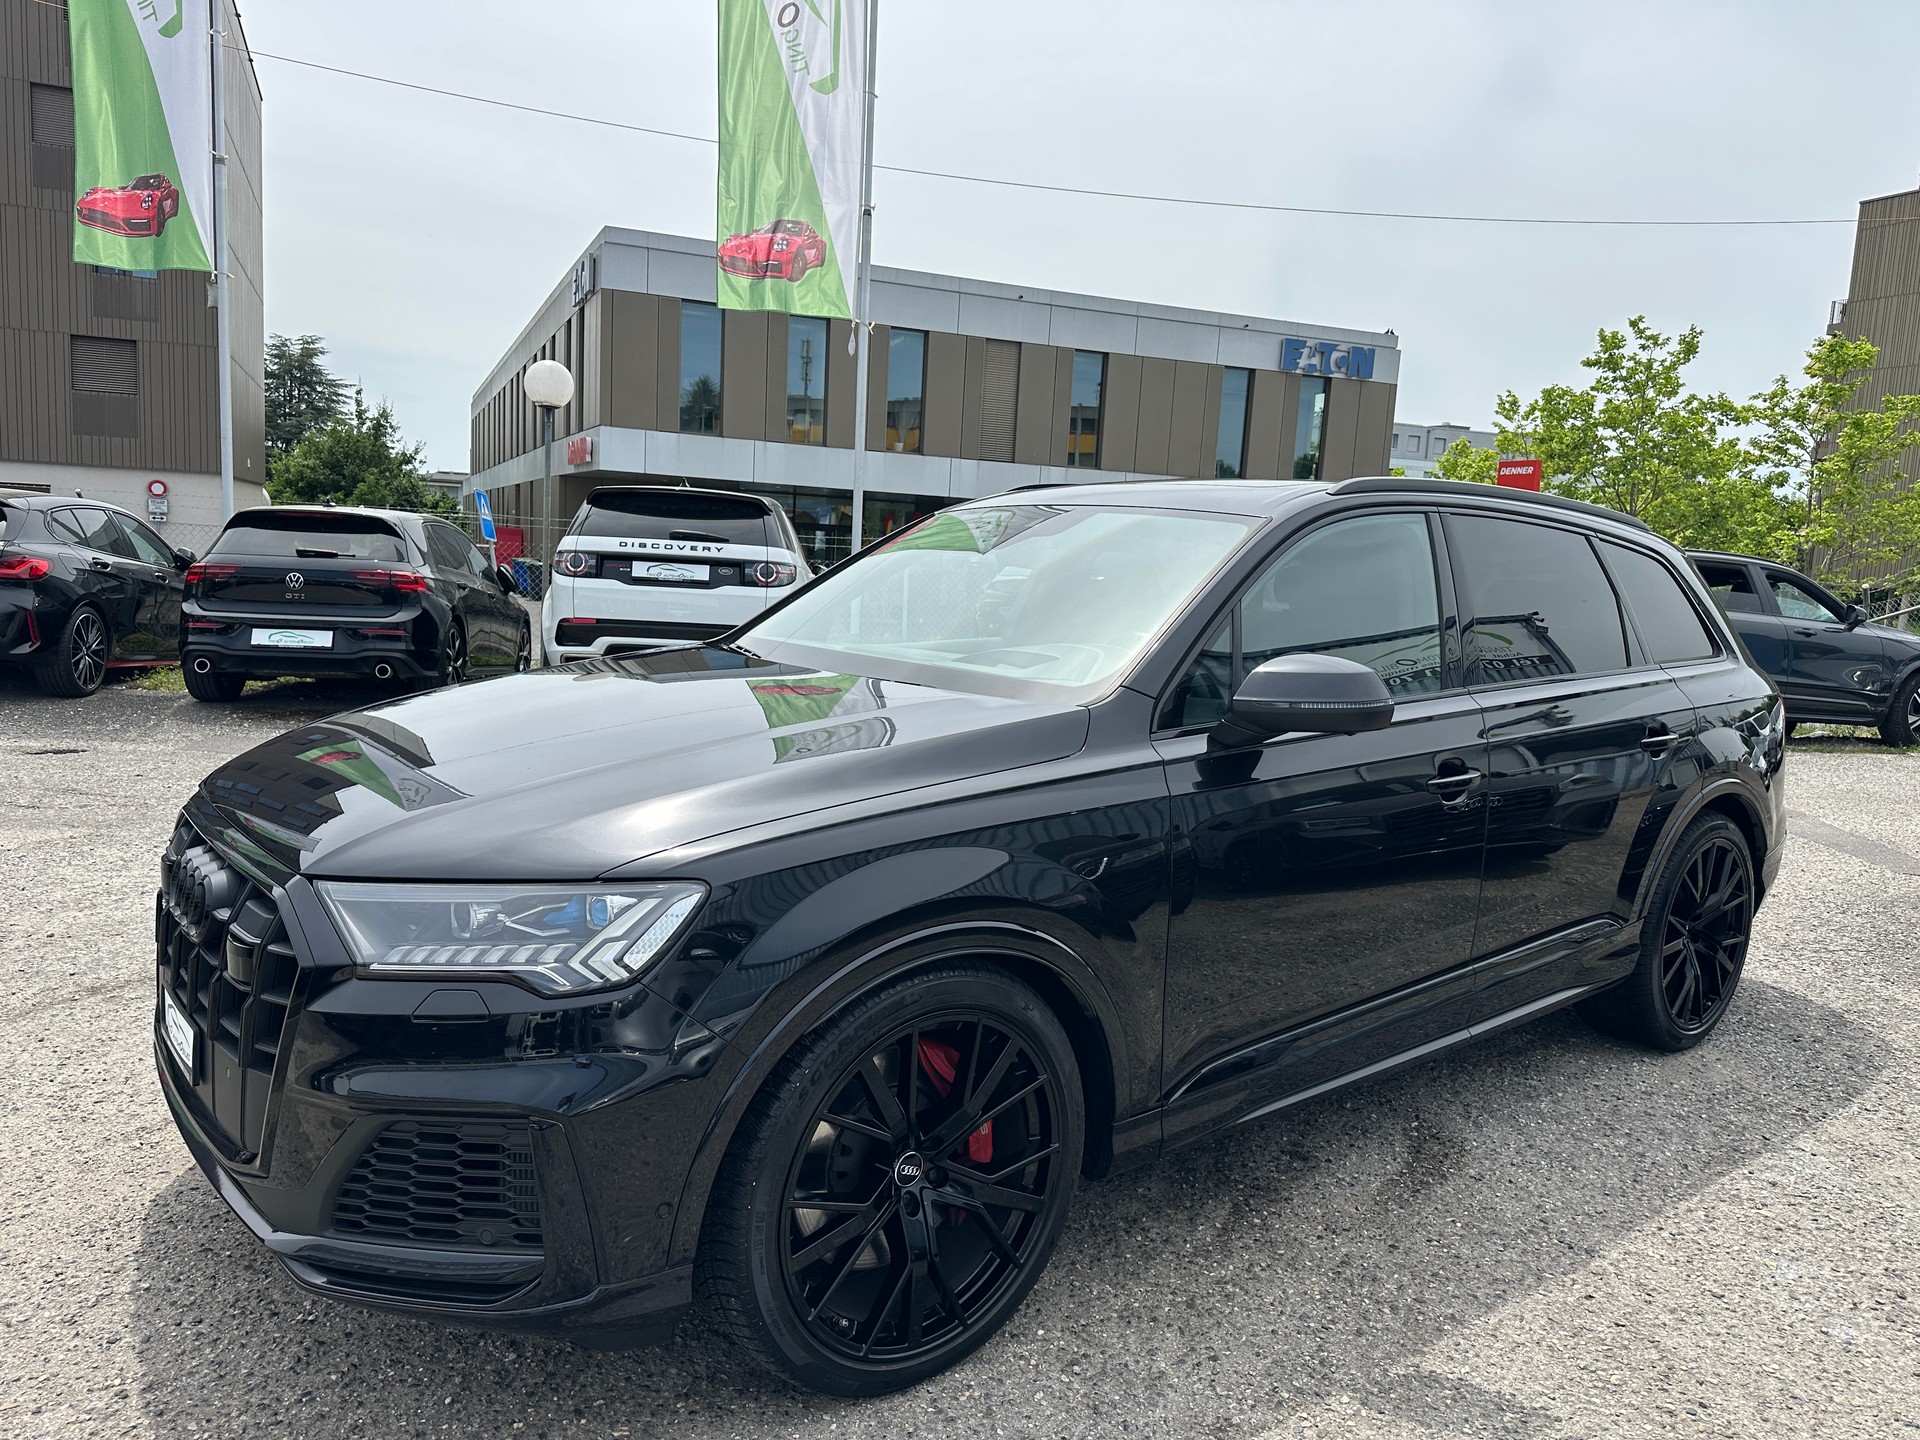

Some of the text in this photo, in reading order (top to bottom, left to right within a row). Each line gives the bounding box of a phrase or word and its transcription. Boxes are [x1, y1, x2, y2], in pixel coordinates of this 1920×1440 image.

[1280, 337, 1375, 379] EATON
[1500, 466, 1534, 475] DENNER
[619, 541, 725, 553] DISCOVERY
